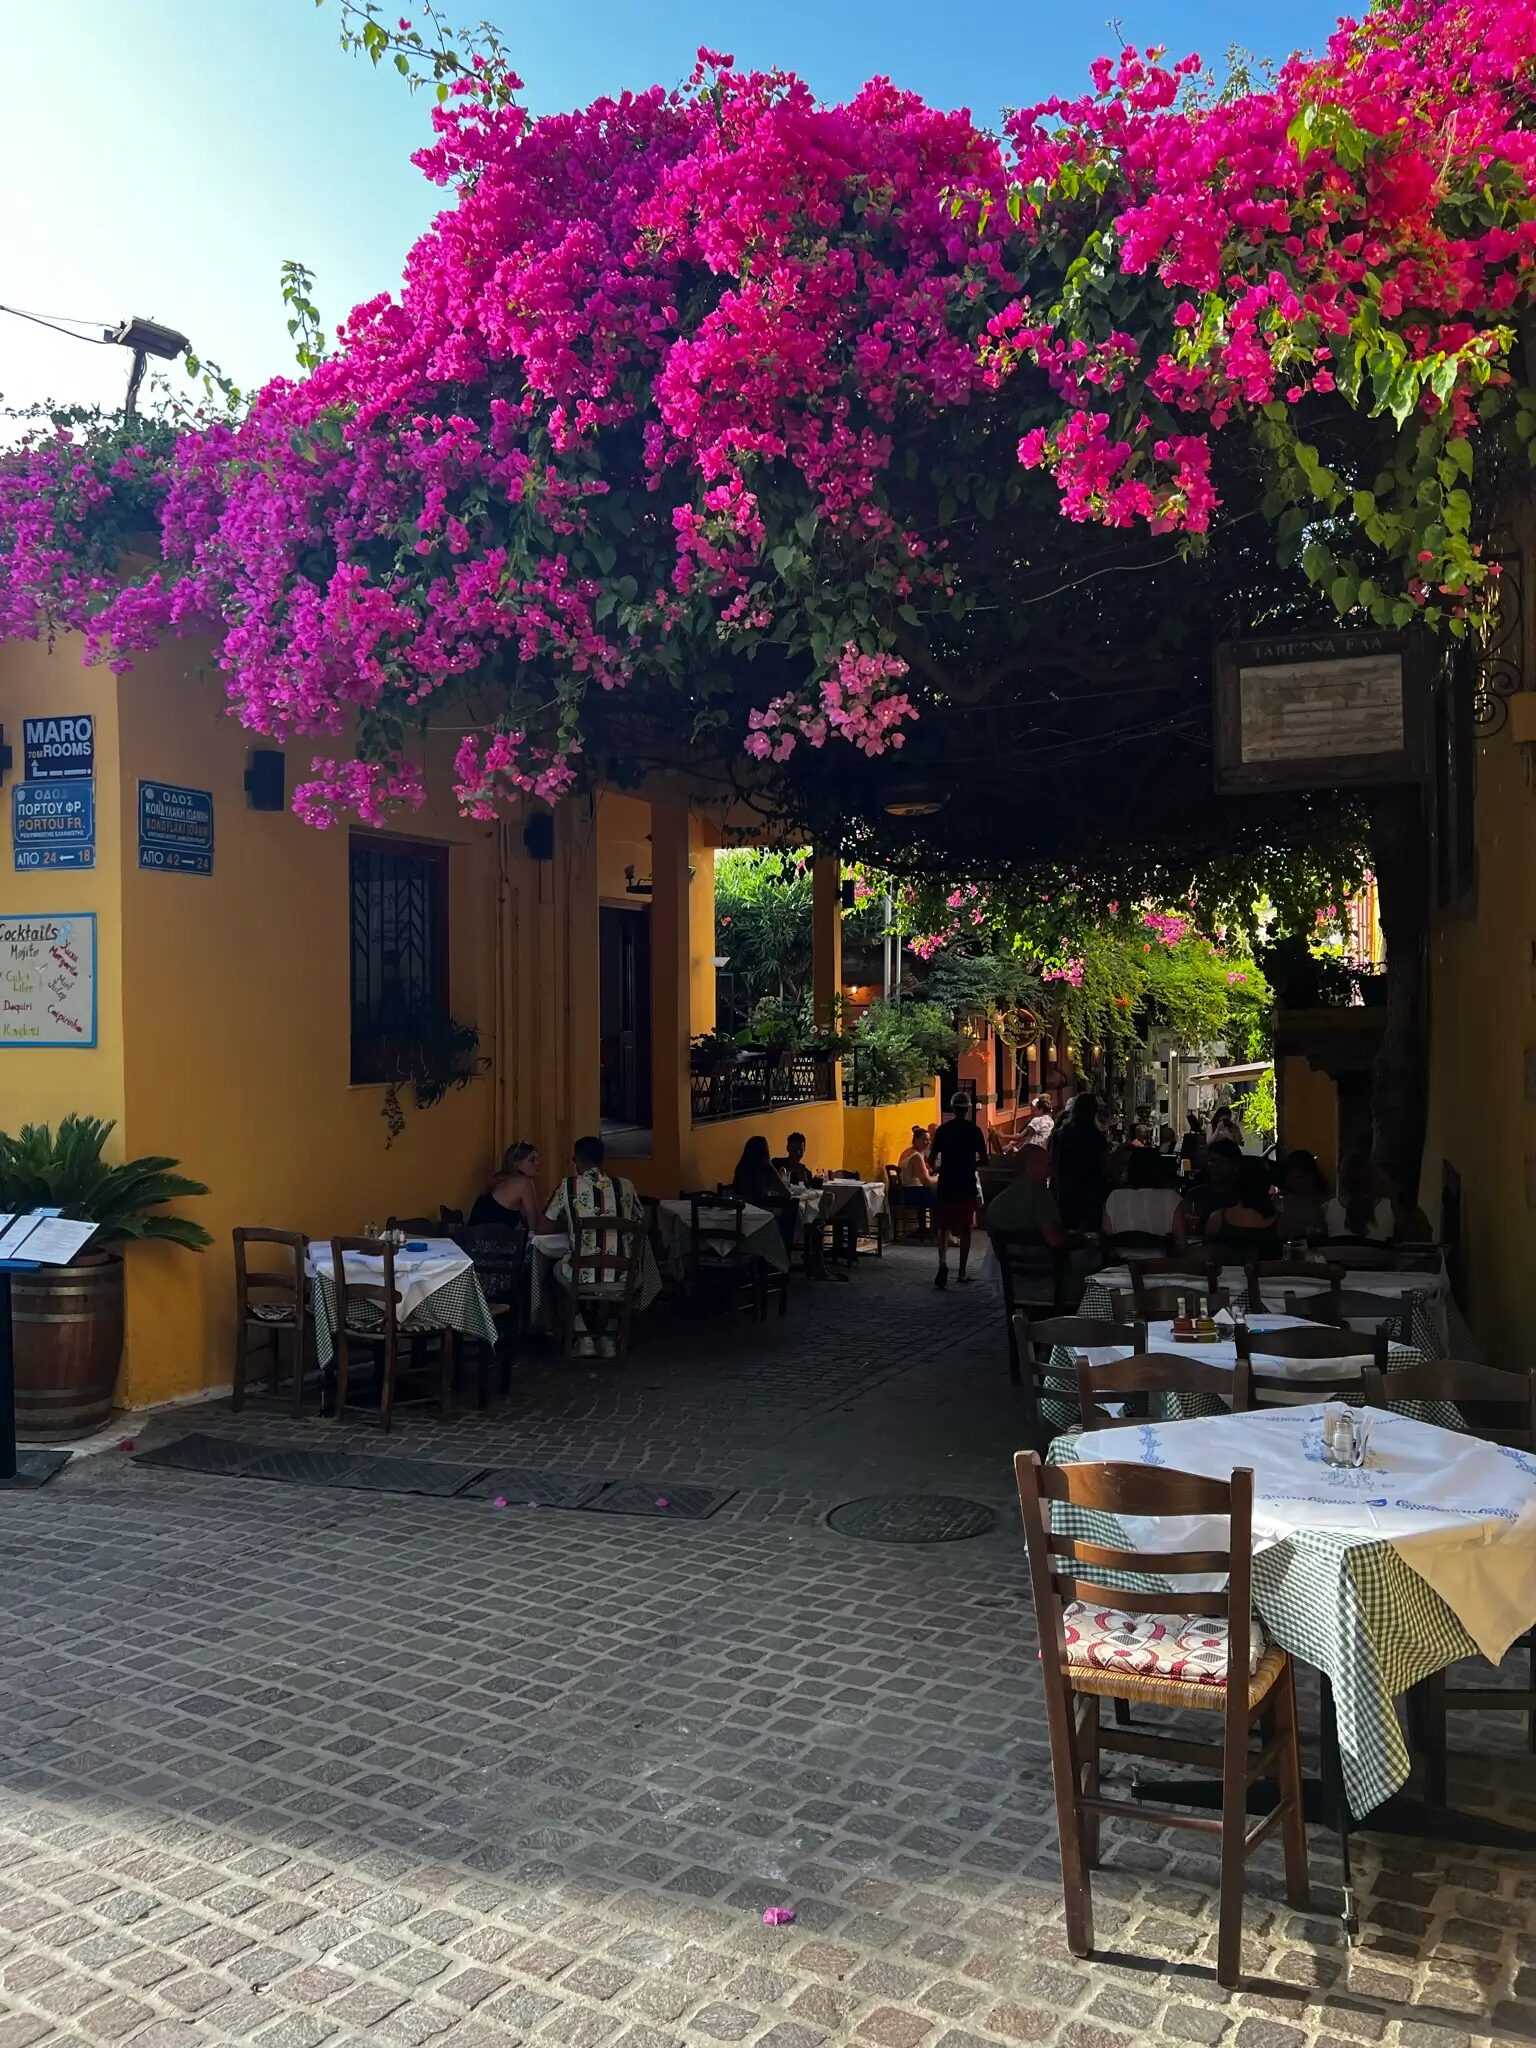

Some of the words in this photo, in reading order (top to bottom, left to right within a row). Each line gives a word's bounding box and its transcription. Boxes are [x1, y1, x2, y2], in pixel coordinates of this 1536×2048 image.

[26, 718, 92, 744] MARO
[43, 742, 92, 757] ROOMS
[34, 789, 69, 800] ΟΔΟΣ
[163, 792, 193, 806] ΟΔΟΣ
[18, 802, 63, 815] ΠΟΡΤΟΥ
[65, 801, 85, 813] ΦΡ.
[145, 802, 185, 818] ΚΟΝΔΥΛΑΚΗ
[18, 818, 64, 830] PORTOU
[67, 817, 86, 829] FR.
[17, 852, 39, 865] ΑΠΟ
[43, 852, 56, 864] 24
[78, 849, 90, 862] 18
[142, 851, 164, 865] ΑΠΟ
[167, 853, 180, 866] 42
[197, 857, 208, 869] 24
[0, 923, 58, 941] Cocktails
[10, 944, 39, 961] Mojito
